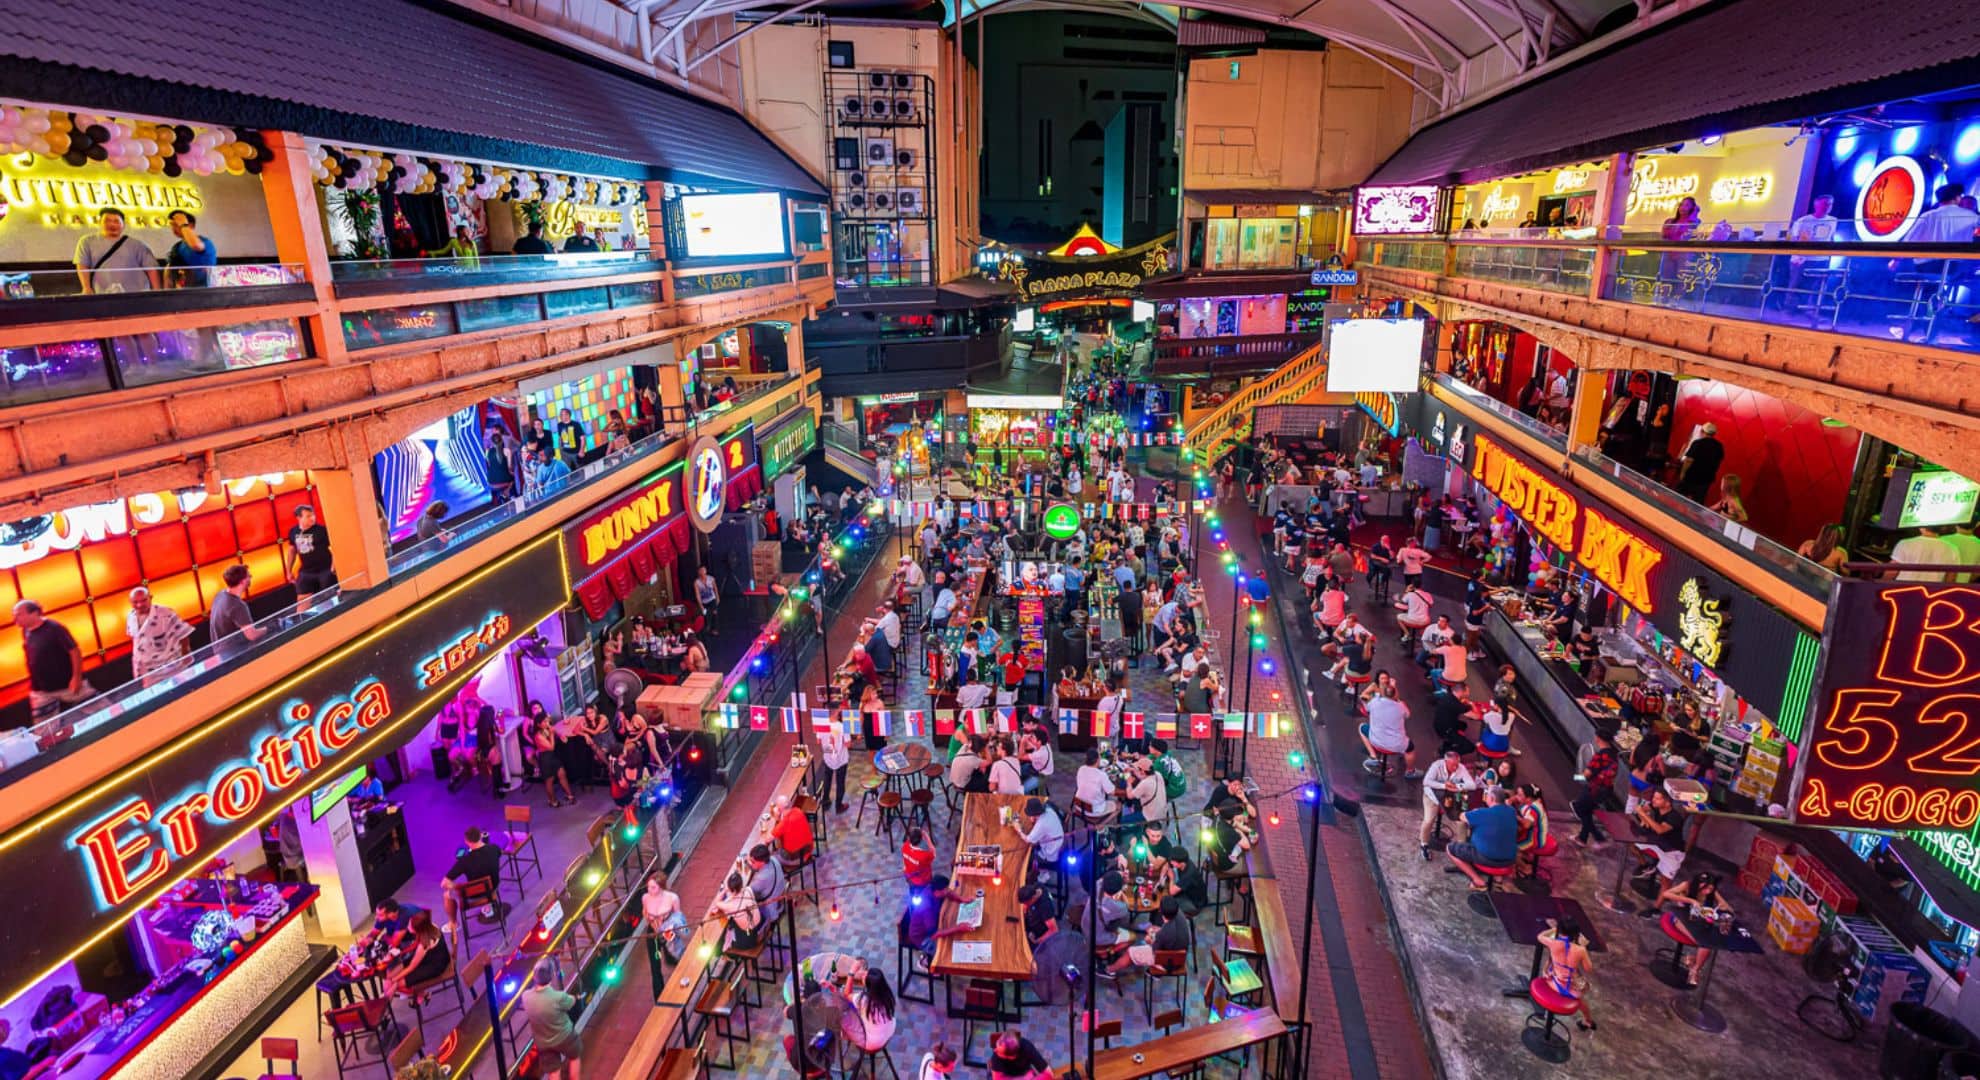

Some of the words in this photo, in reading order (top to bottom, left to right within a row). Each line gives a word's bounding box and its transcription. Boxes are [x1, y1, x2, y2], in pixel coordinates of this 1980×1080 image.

[0, 166, 203, 209] UTTERFLIES
[1029, 274, 1083, 296] NANA
[1085, 271, 1141, 288] PLAZA
[1313, 273, 1355, 283] RANDOM
[728, 440, 745, 469] 2
[583, 481, 672, 566] BUNNY
[1473, 433, 1578, 552] TWISTER
[1576, 507, 1662, 614] BKK
[1817, 690, 1980, 775] 52
[76, 681, 392, 906] Erotica
[1800, 779, 1980, 828] A-GOGO
